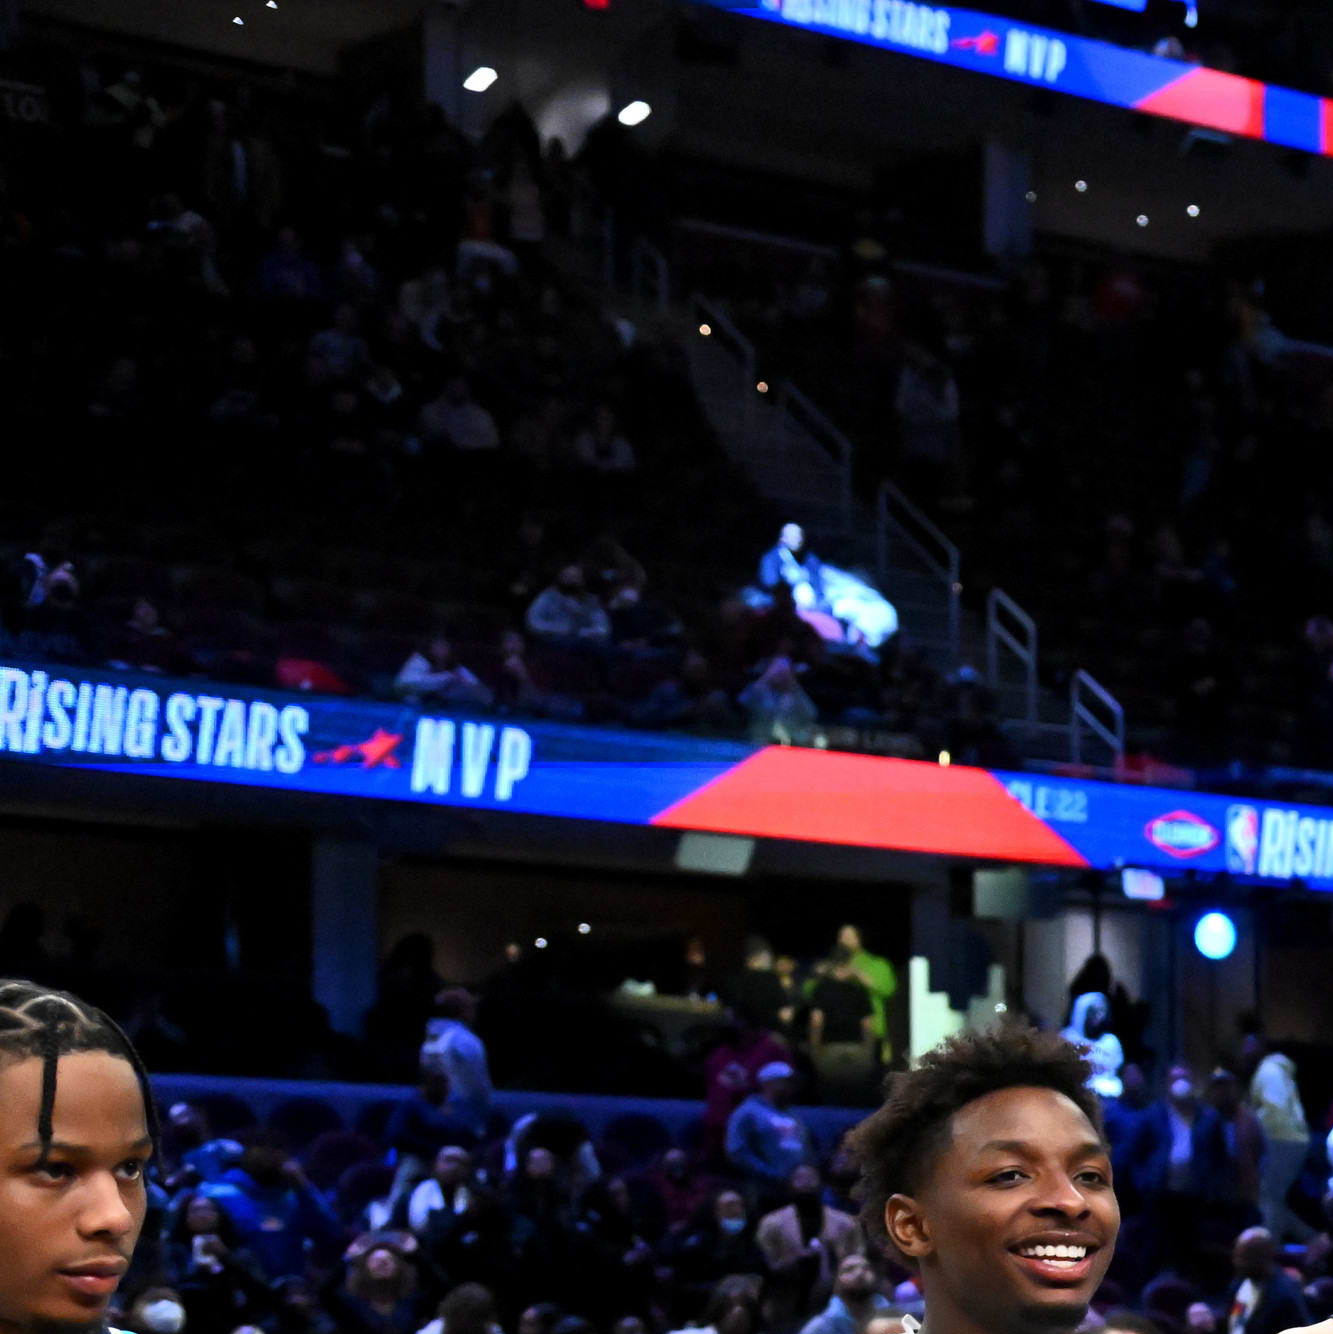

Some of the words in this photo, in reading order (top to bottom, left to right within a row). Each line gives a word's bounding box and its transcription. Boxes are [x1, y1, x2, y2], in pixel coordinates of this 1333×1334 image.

[0, 665, 157, 762] RISING
[161, 691, 310, 775] STARS
[409, 716, 532, 801] MVP
